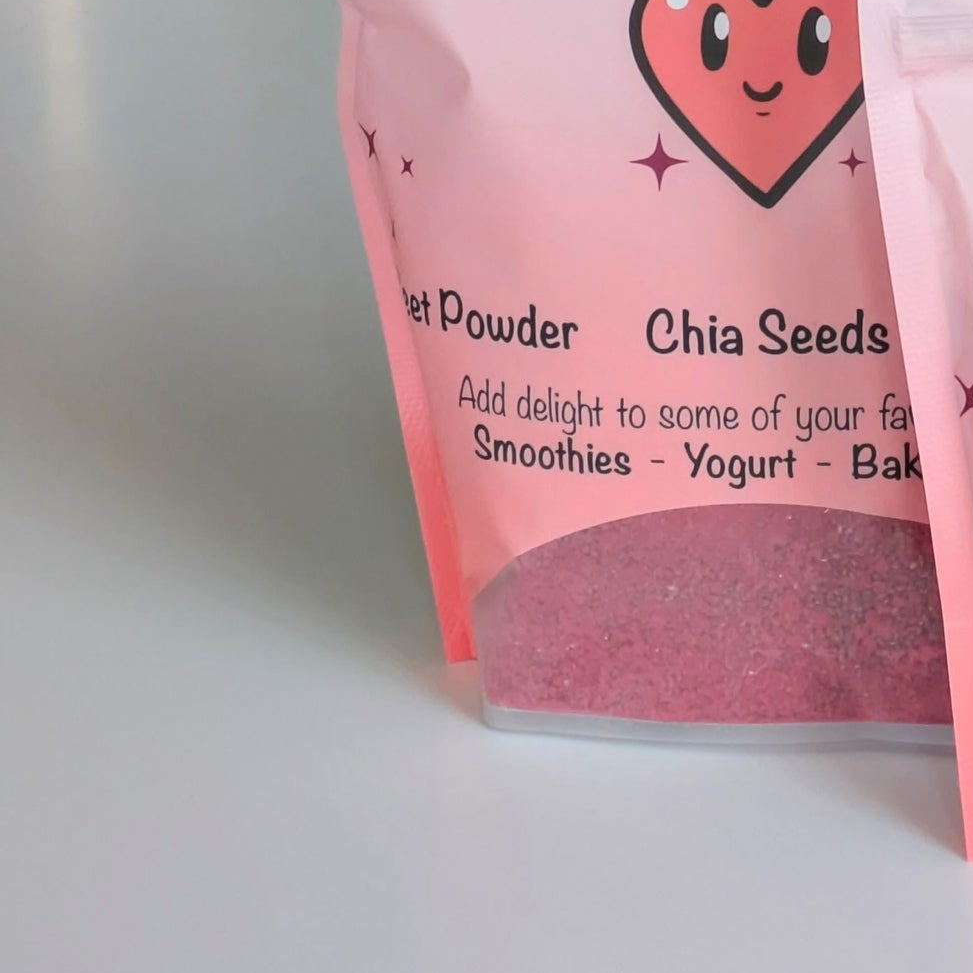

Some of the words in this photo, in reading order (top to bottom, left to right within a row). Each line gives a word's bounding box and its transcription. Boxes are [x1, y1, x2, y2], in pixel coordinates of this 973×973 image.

[402, 287, 431, 326] et
[439, 288, 578, 350] Powder
[646, 308, 743, 356] Chia
[758, 308, 891, 356] Seeds
[459, 375, 506, 417] Add
[517, 385, 604, 436] delight
[616, 398, 646, 429] to
[659, 405, 739, 430] some
[752, 394, 786, 431] of
[796, 406, 865, 442] your
[474, 424, 632, 476] Smoothies
[684, 442, 797, 489] Yogurt
[852, 441, 923, 481] Bak
